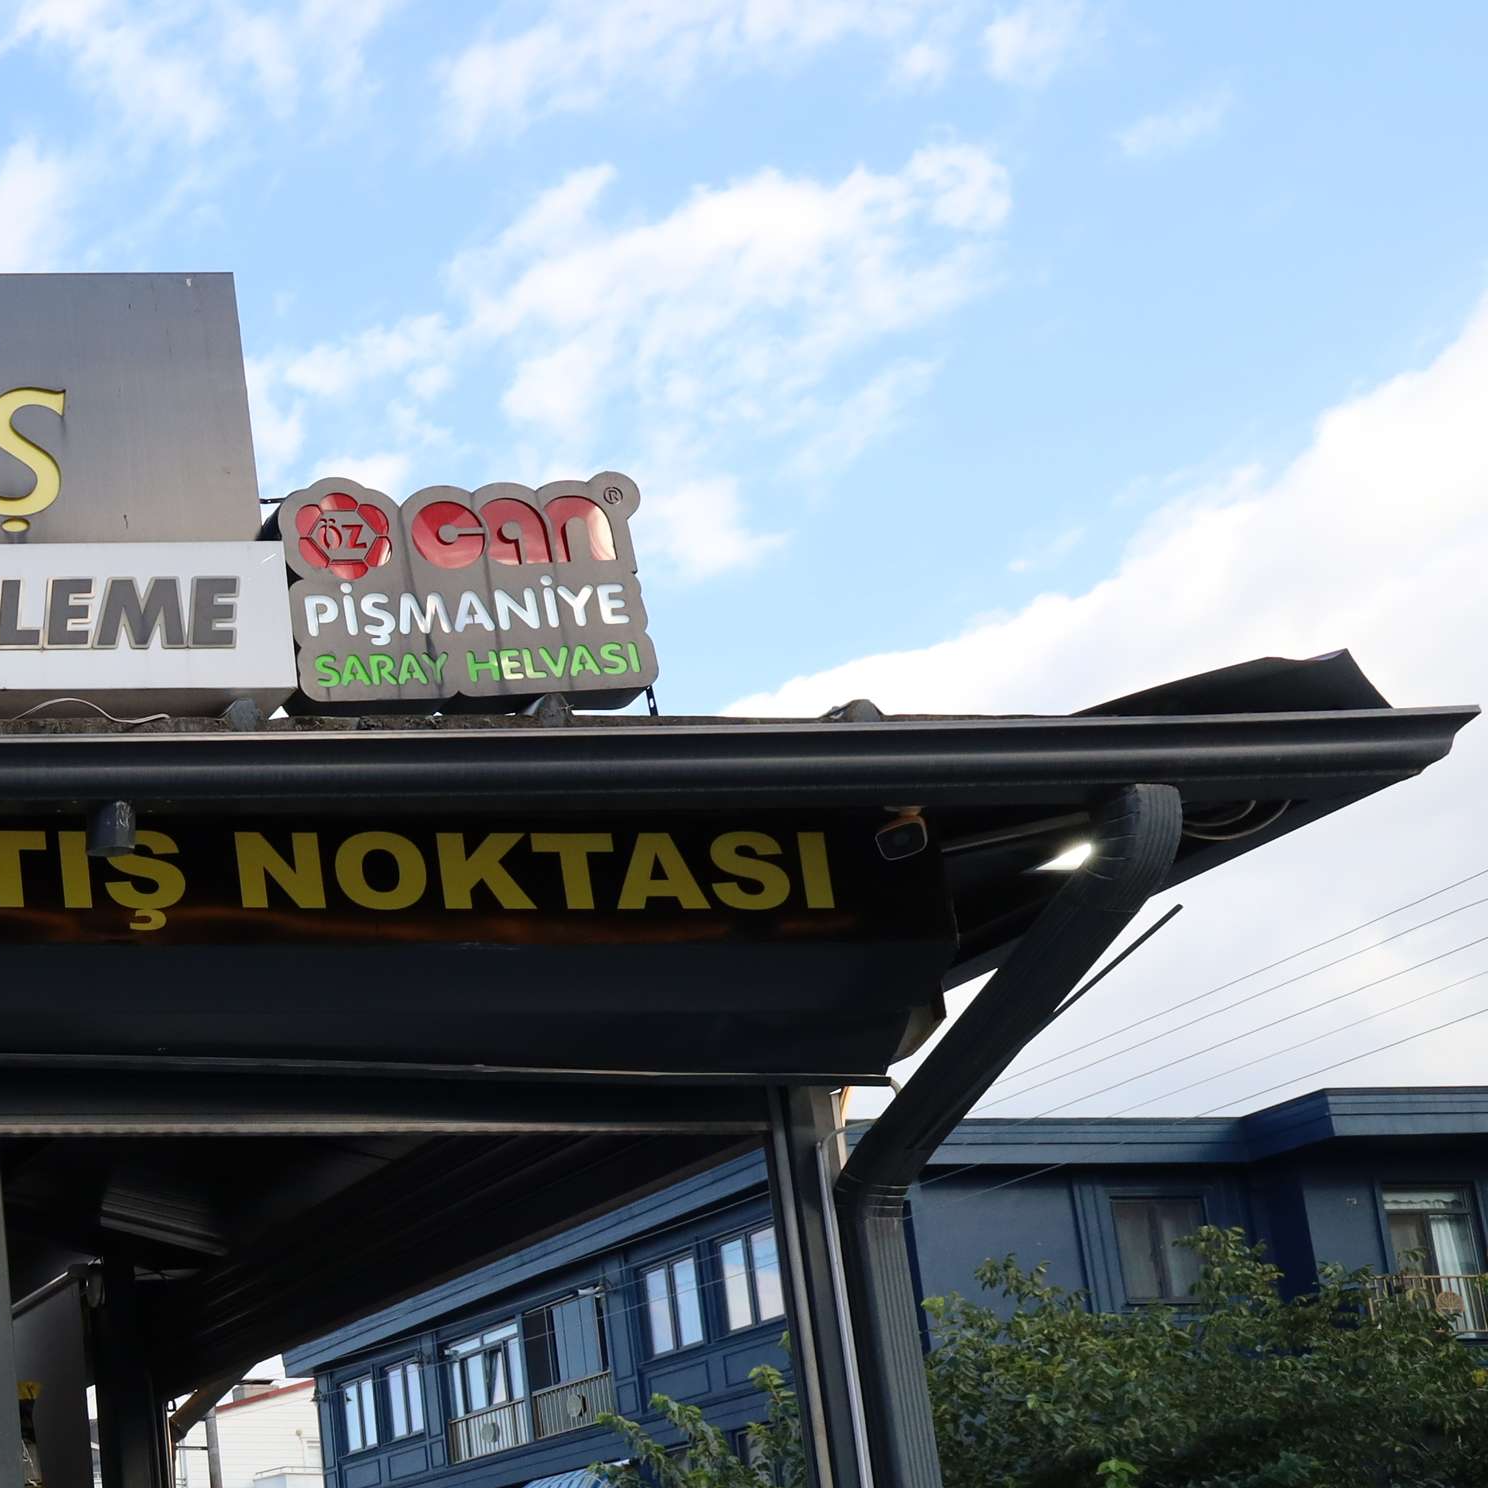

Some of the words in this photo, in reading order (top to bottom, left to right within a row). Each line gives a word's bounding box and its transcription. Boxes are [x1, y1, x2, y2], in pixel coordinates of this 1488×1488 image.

[304, 575, 630, 646] PİŞMANİYE
[315, 651, 449, 688] SARAY
[466, 642, 642, 682] HELVASI
[235, 831, 836, 911] NOKTASI
